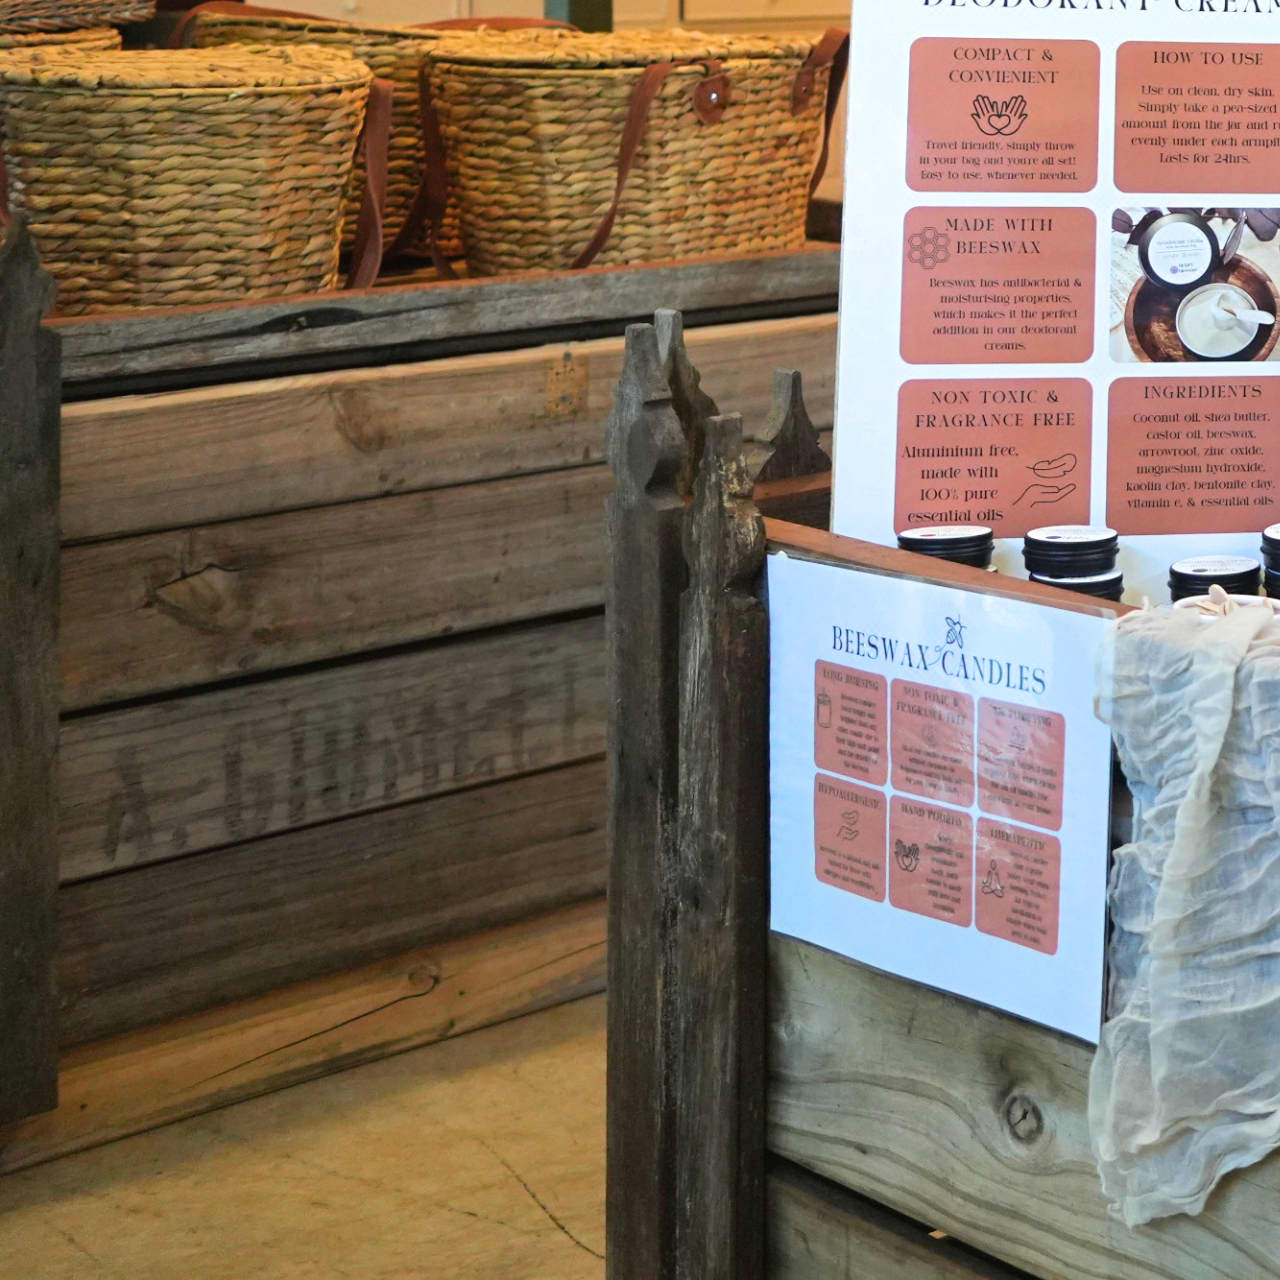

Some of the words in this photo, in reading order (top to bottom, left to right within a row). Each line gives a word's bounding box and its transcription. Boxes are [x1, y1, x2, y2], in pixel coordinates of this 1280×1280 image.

[953, 47, 1035, 61] COMPACT
[1041, 49, 1053, 61] &
[1154, 51, 1193, 64] HOW
[1200, 52, 1224, 65] TO
[1232, 53, 1263, 65] USE
[949, 70, 1058, 84] CONVIENIENT
[1141, 85, 1163, 95] Use
[1168, 87, 1183, 95] on
[1224, 87, 1243, 97] dry
[1138, 102, 1179, 114] Simply
[1184, 103, 1207, 112] take
[1223, 104, 1277, 114] pea-sized
[1121, 119, 1167, 129] amount
[1172, 120, 1200, 129] from
[1205, 120, 1222, 129] the
[1226, 120, 1240, 131] jar
[1247, 121, 1272, 130] and
[1131, 136, 1168, 147] evenly
[1173, 136, 1206, 146] under
[1211, 137, 1237, 146] each
[1160, 153, 1189, 163] Lasts
[1193, 153, 1209, 163] for
[945, 218, 994, 231] MADE
[1005, 218, 1052, 231] WITH
[957, 241, 1041, 254] BEESWAX
[931, 391, 969, 404] NON
[980, 390, 1038, 403] TOXIC
[1046, 389, 1059, 403] &
[1144, 385, 1263, 399] INGREDIENTS
[916, 413, 1024, 428] FRAGRANCE
[1033, 412, 1075, 426] FREE
[1133, 412, 1179, 423] Coconut
[1204, 412, 1231, 421] shea
[1146, 429, 1182, 439] castor
[902, 446, 983, 458] Aluminium
[1204, 447, 1225, 456] zinc
[921, 467, 961, 479] made
[968, 466, 999, 478] with
[1137, 463, 1201, 476] magnesium
[1194, 480, 1247, 490] bentonite
[920, 489, 958, 501] 100%
[965, 489, 998, 502] pure
[1127, 499, 1169, 508] vitamin
[1187, 497, 1196, 507] &
[1200, 496, 1250, 507] essential
[1254, 496, 1274, 506] oils
[908, 510, 971, 523] essential
[977, 510, 1003, 521] oils
[832, 626, 929, 670] BEESWAX
[941, 651, 1046, 695] CANDLES
